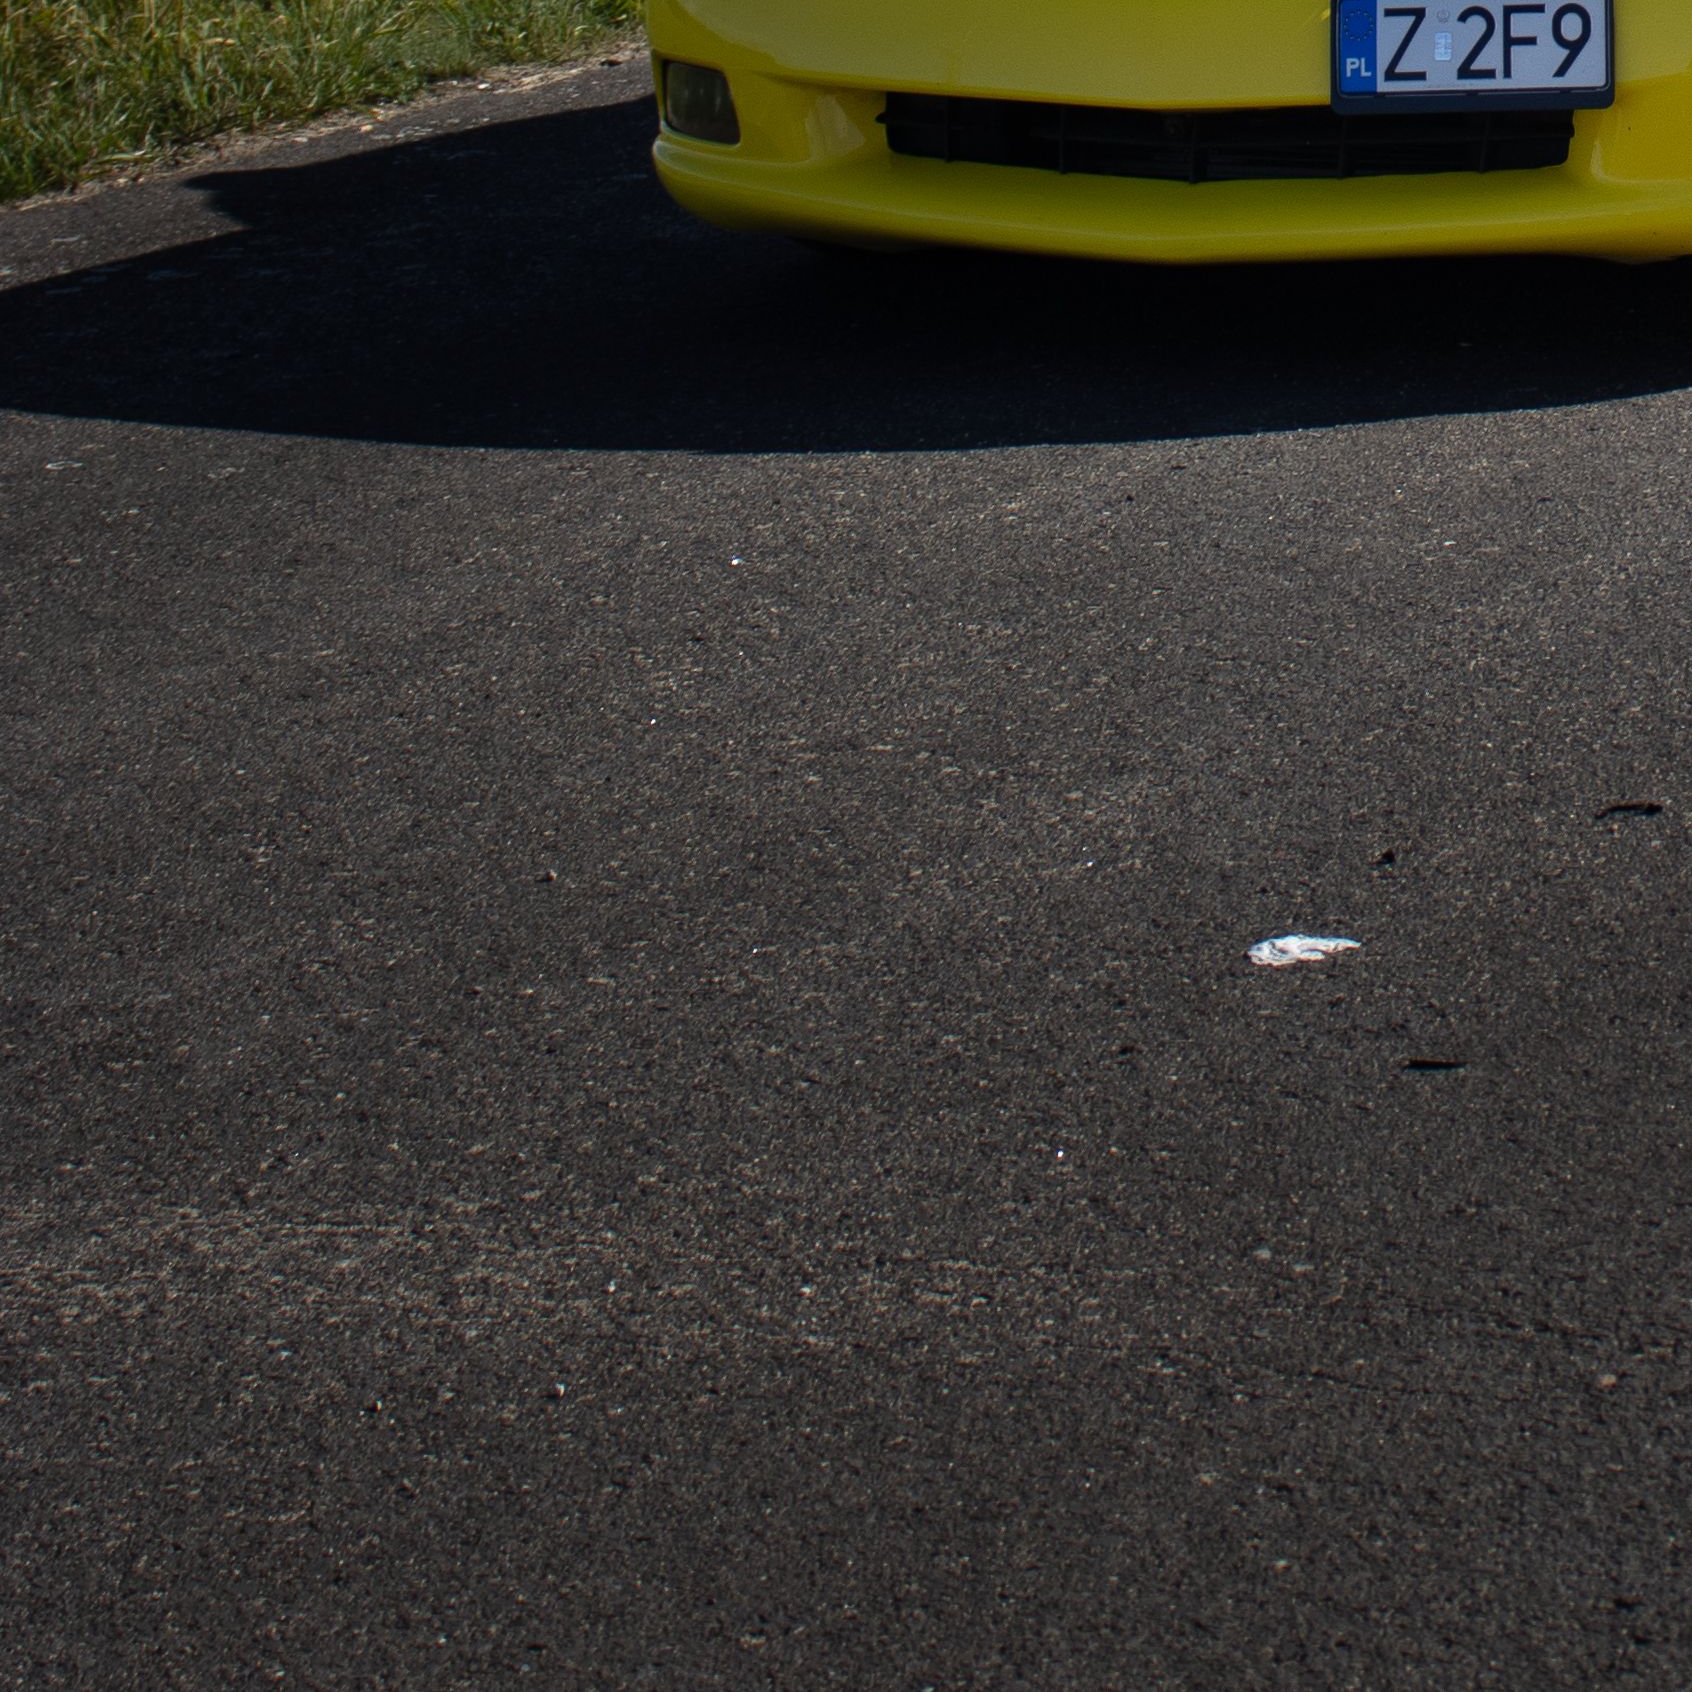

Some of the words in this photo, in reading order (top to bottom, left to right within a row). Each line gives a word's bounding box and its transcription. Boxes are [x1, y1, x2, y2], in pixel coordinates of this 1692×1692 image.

[1346, 57, 1372, 78] PL
[1383, 6, 1428, 83] Z
[1456, 2, 1592, 80] 2F9
